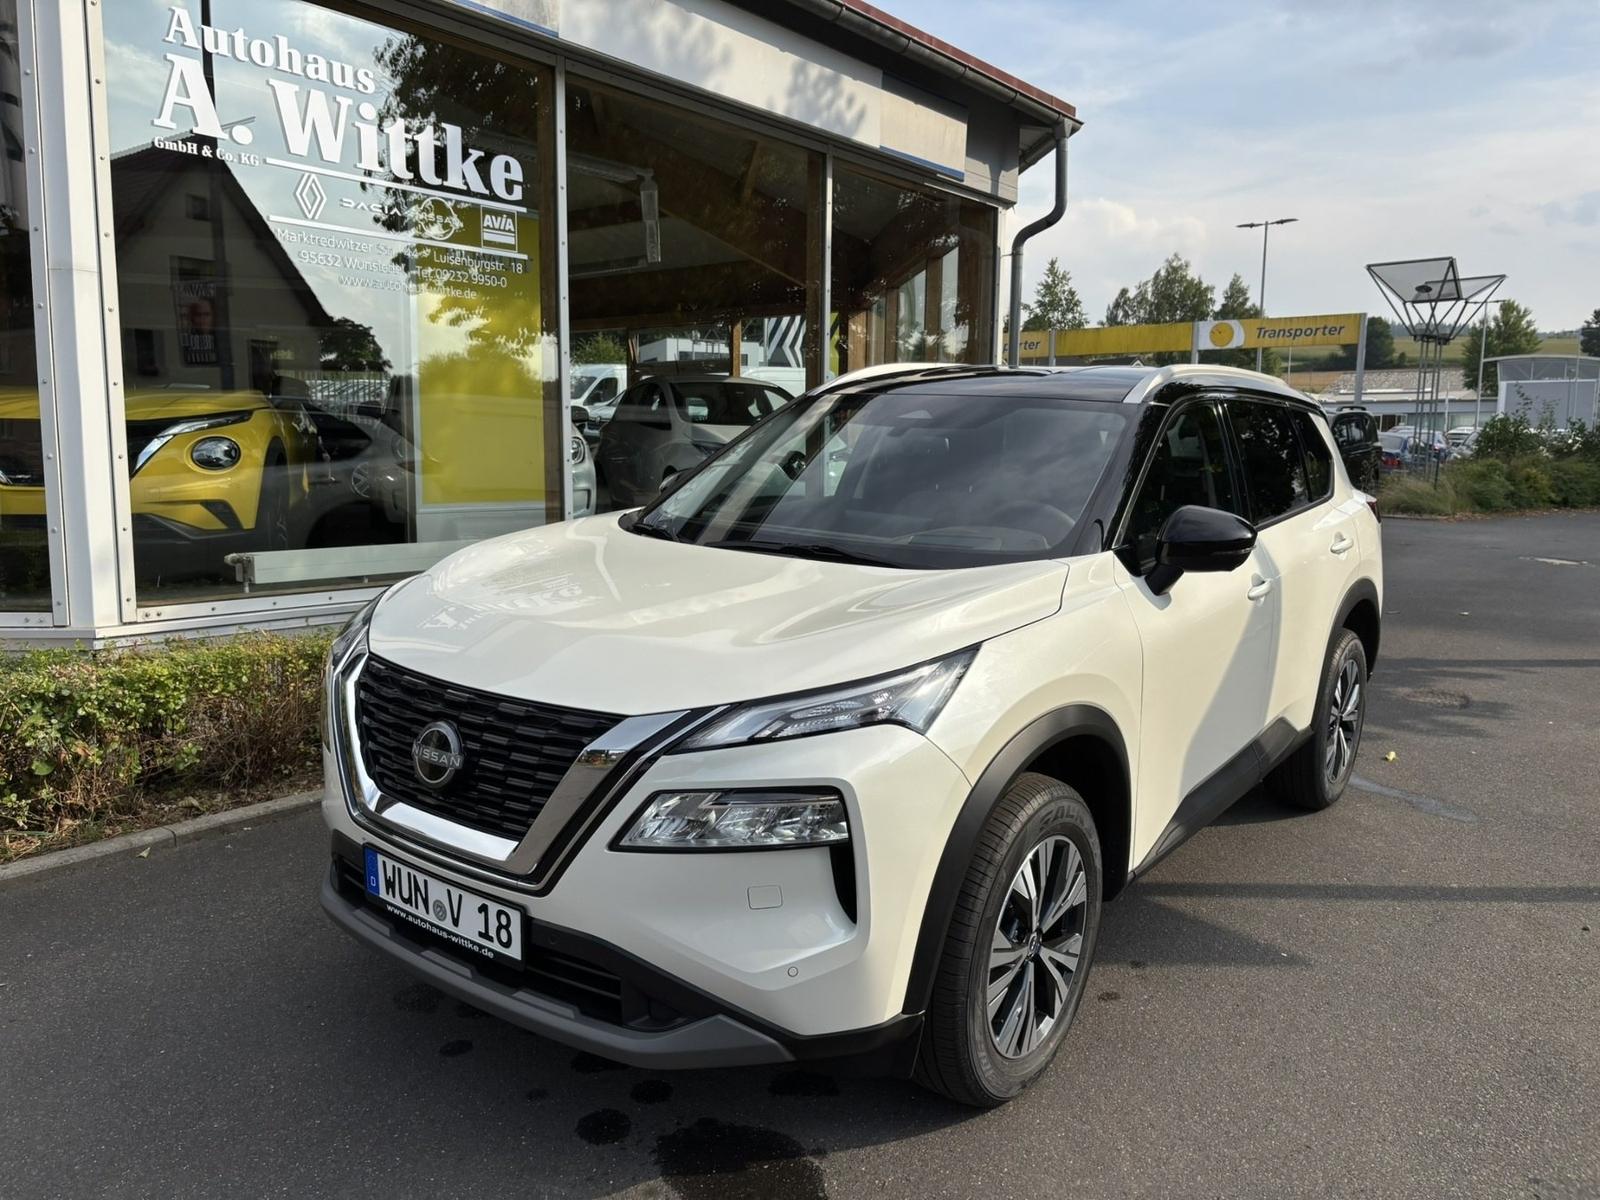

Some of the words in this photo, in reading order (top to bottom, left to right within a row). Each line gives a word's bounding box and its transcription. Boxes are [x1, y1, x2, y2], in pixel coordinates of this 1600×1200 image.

[164, 6, 376, 94] Autohaus
[152, 52, 254, 146] A.
[267, 77, 525, 202] Wittke
[154, 135, 199, 156] GmbH
[201, 144, 213, 158] &
[216, 147, 237, 162] Co.
[239, 152, 260, 166] KG
[276, 227, 373, 253] Marktredwitzer
[432, 250, 506, 273] Luisenburgstr.
[511, 262, 524, 275] 18
[299, 249, 342, 268] 95632
[1256, 323, 1345, 340] Transporter
[411, 740, 461, 768] NISSAN
[381, 859, 431, 916] WUN
[446, 887, 463, 929] V
[477, 902, 513, 950] 18
[386, 903, 495, 960] www.autohaus-wittke.de
